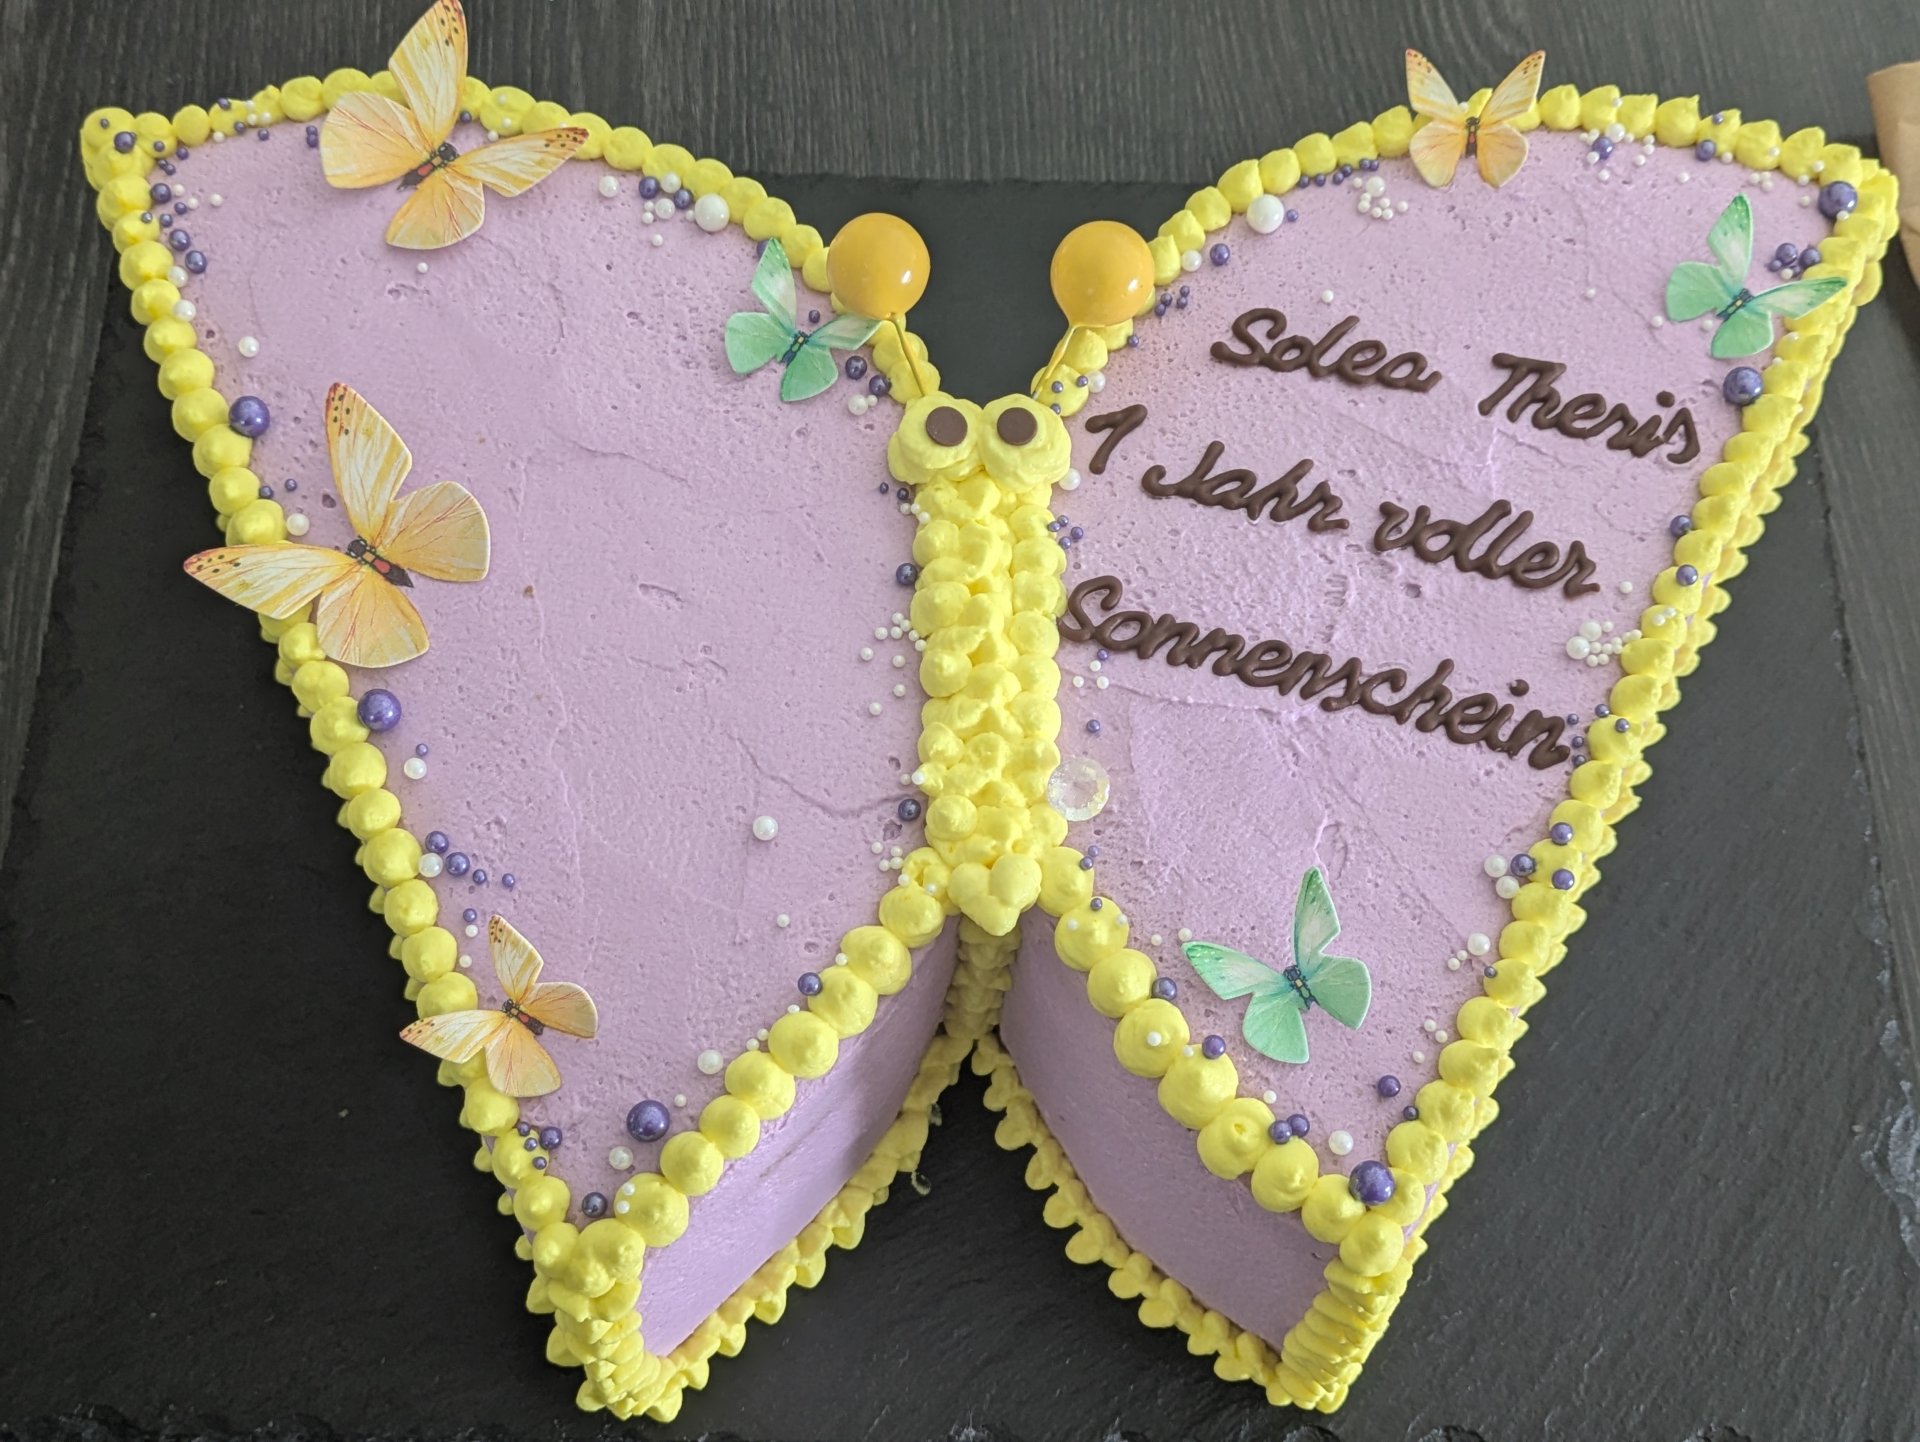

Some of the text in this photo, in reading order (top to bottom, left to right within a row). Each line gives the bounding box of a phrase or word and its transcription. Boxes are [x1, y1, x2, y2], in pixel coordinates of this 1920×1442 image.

[1210, 307, 1441, 393] Solea
[1084, 404, 1601, 599] 1 Jahr voller
[1057, 575, 1571, 770] Sonnenschein
